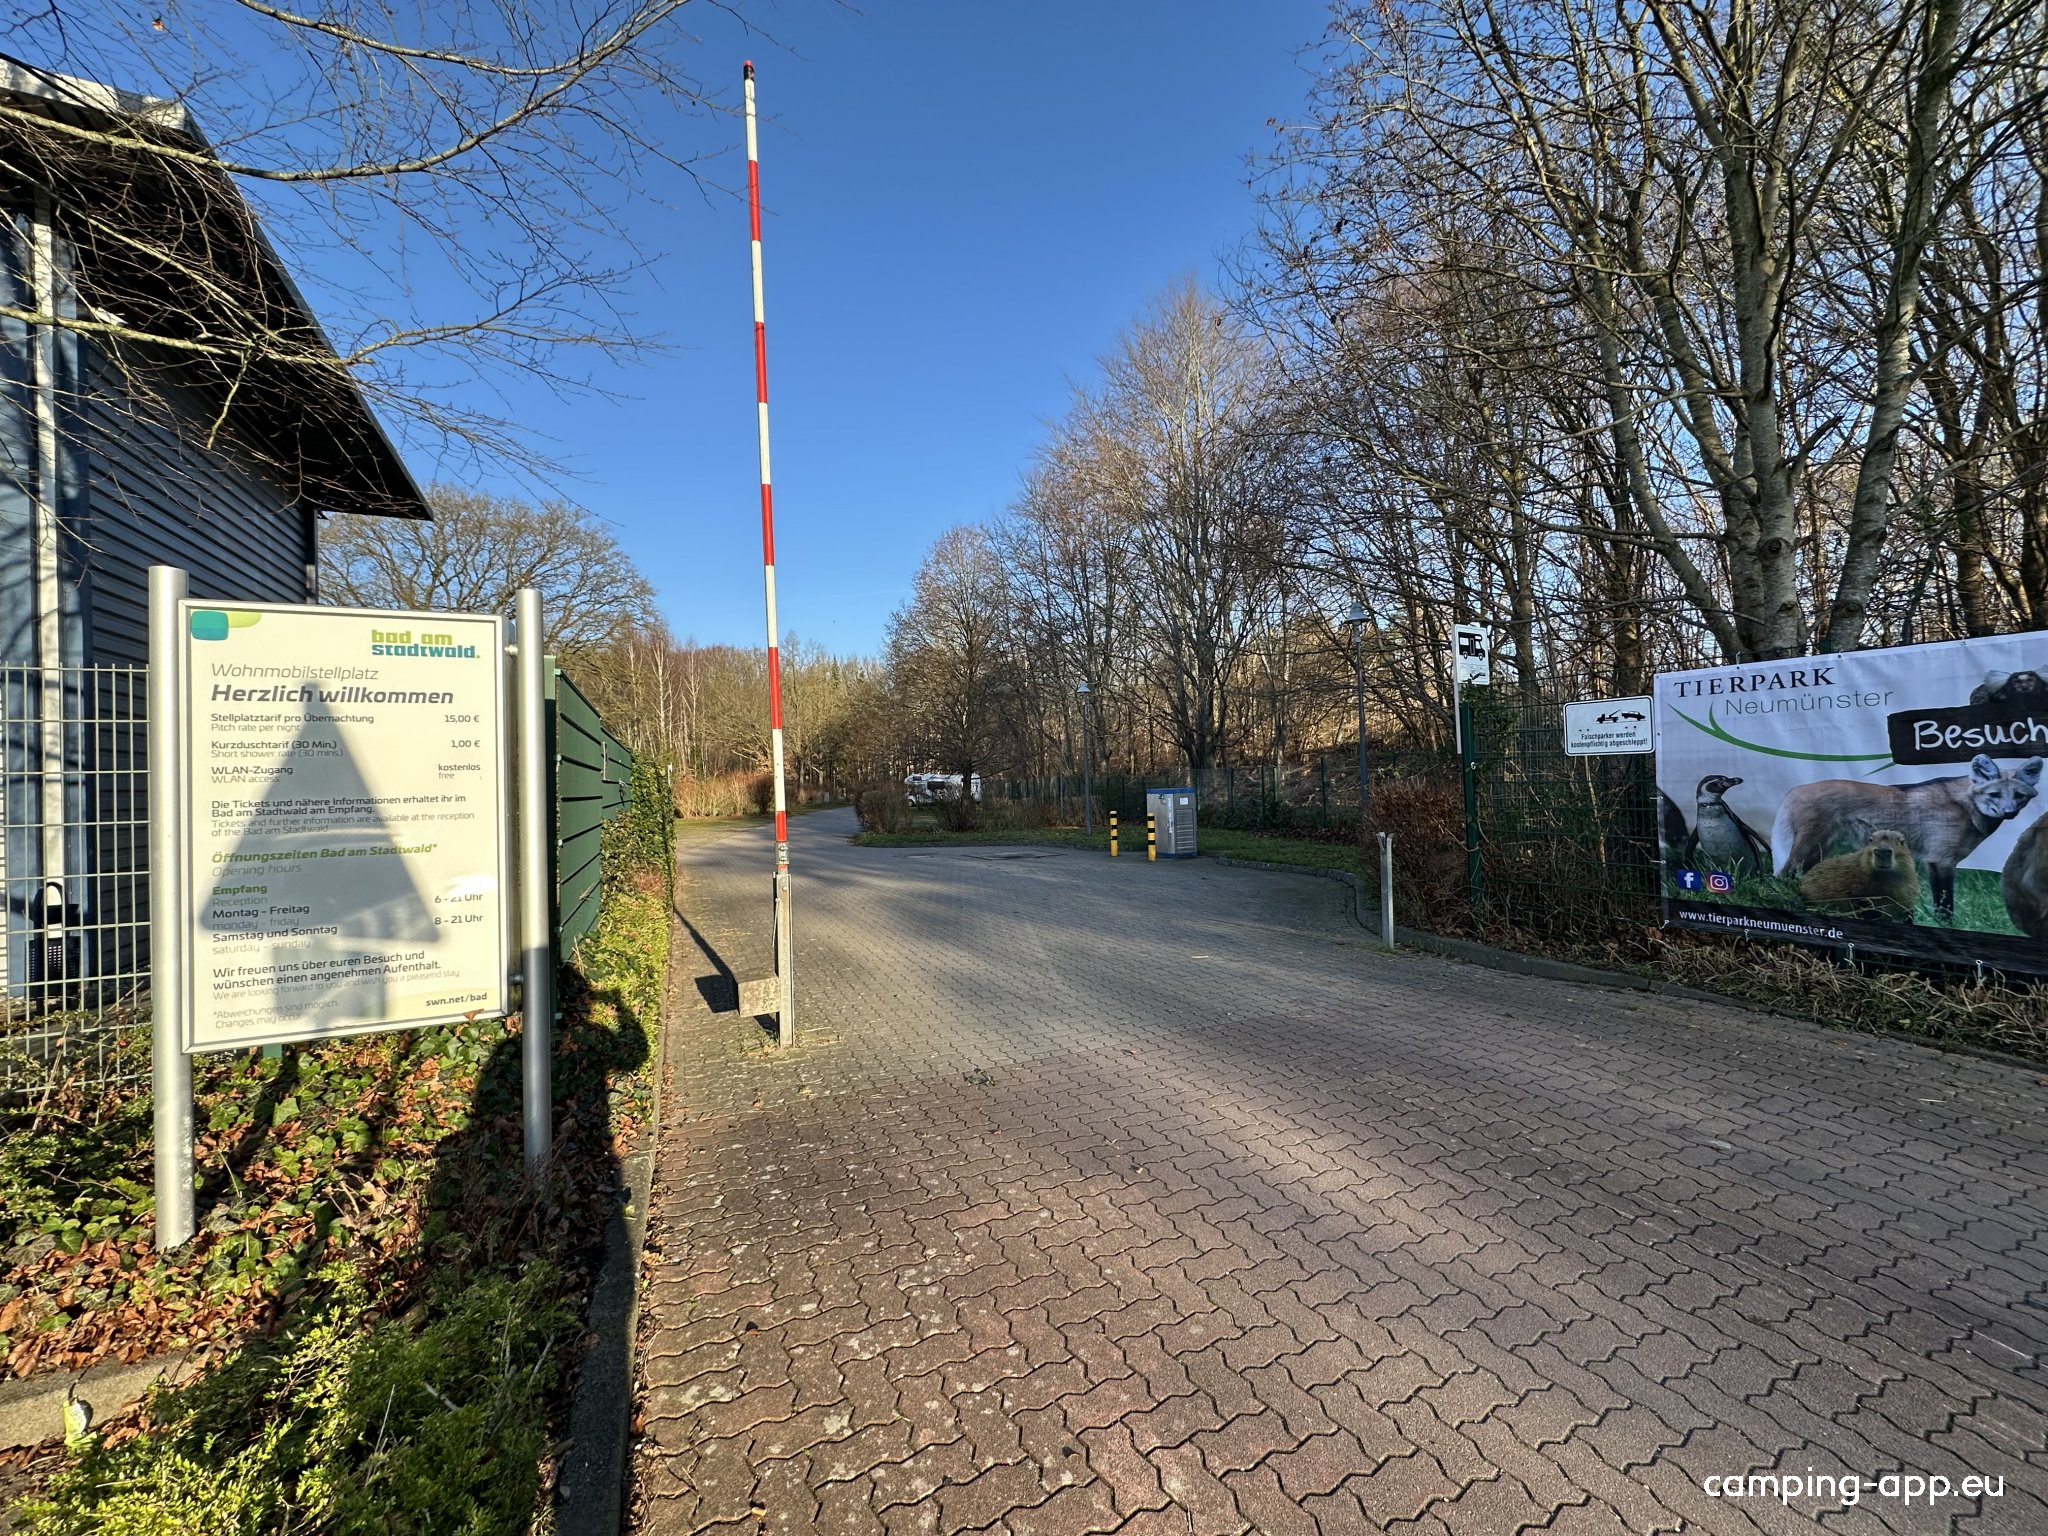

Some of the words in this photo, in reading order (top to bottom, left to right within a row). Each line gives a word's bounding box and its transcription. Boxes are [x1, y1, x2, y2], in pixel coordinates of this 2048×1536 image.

[371, 629, 411, 644] bad
[421, 633, 453, 645] am
[371, 643, 480, 659] stadtwald.
[211, 663, 379, 682] Wohnmobilstellplatz
[1674, 667, 1836, 698] TIERPARK
[211, 684, 313, 702] Herzlich
[319, 686, 454, 704] willkommen
[1726, 690, 1895, 715] Neumünster
[211, 713, 281, 723] Stellplatztarif
[304, 713, 374, 724] Übernachtung
[444, 715, 471, 723] 15,00
[473, 715, 480, 723] €
[211, 724, 235, 732] Pitch
[259, 725, 274, 733] per
[277, 724, 301, 733] night
[1581, 732, 1614, 740] Falschparker
[1615, 731, 1636, 739] werden
[1913, 717, 2048, 751] Besuch
[211, 741, 289, 749] Kurzduschtarif
[291, 740, 309, 750] (30
[312, 740, 337, 750] Min.)
[451, 740, 471, 748] 1,00
[474, 740, 481, 748] €
[1571, 740, 1608, 748] kostenpflichtig
[1609, 738, 1648, 747] abgeschleppt!
[211, 750, 238, 758] Short
[240, 750, 274, 758] shower
[298, 749, 314, 758] (30
[317, 749, 343, 758] mins.)
[211, 766, 294, 775] WLAN-Zugang
[438, 763, 481, 772] kostenlos
[211, 775, 246, 783] WLAN
[212, 800, 229, 808] Die
[232, 800, 270, 808] Tickets
[273, 799, 293, 807] und
[295, 798, 330, 806] nähere
[333, 797, 400, 806] Informationen
[455, 794, 466, 802] im
[212, 809, 233, 817] Bad
[255, 807, 307, 816] Stadtwald
[328, 805, 375, 815] Empfang.
[212, 820, 245, 828] Tickets
[248, 819, 266, 827] and
[269, 818, 300, 826] further
[303, 816, 355, 825] information
[373, 814, 409, 823] available
[421, 813, 435, 821] the
[437, 813, 474, 822] reception
[212, 829, 222, 837] of
[224, 828, 240, 836] the
[243, 827, 263, 835] Bad
[283, 825, 329, 834] Stadtwald
[212, 850, 317, 863] Öffnungszeiten
[320, 848, 345, 858] Bad
[347, 848, 366, 857] am
[212, 865, 265, 878] Opening
[268, 863, 302, 874] hours
[212, 885, 268, 896] Empfang
[212, 896, 268, 907] Reception
[434, 895, 442, 903] 6
[465, 894, 483, 902] Uhr
[212, 909, 259, 919] Montag
[270, 905, 310, 915] Freitag
[212, 920, 258, 931] monday
[270, 917, 300, 927] friday
[434, 917, 442, 925] 8
[450, 915, 462, 923] 21
[465, 914, 484, 923] Uhr
[1679, 910, 1844, 940] www.tierparkneumuenster.de
[213, 931, 264, 942] Samstag
[266, 928, 288, 938] und
[291, 926, 338, 937] Sonntag
[212, 943, 260, 955] saturday
[271, 939, 311, 950] sunday
[213, 967, 236, 978] Wir
[237, 965, 276, 976] freuen
[278, 963, 299, 973] uns
[302, 960, 327, 970] über
[329, 958, 361, 968] euren
[363, 952, 402, 965] Besuch
[405, 950, 425, 961] und
[213, 977, 274, 990] wünschen
[276, 973, 307, 984] einen
[310, 966, 383, 981] angenehmen
[383, 961, 441, 974] Aufenthalt.
[212, 991, 229, 1000] We
[231, 990, 245, 998] are
[247, 987, 278, 997] looking
[280, 983, 313, 994] forward
[315, 982, 324, 990] to
[326, 981, 341, 990] you
[426, 992, 488, 1007] swn.net/bad
[285, 1002, 303, 1012] sind
[215, 1018, 254, 1029] Changes
[256, 1016, 276, 1025] may
